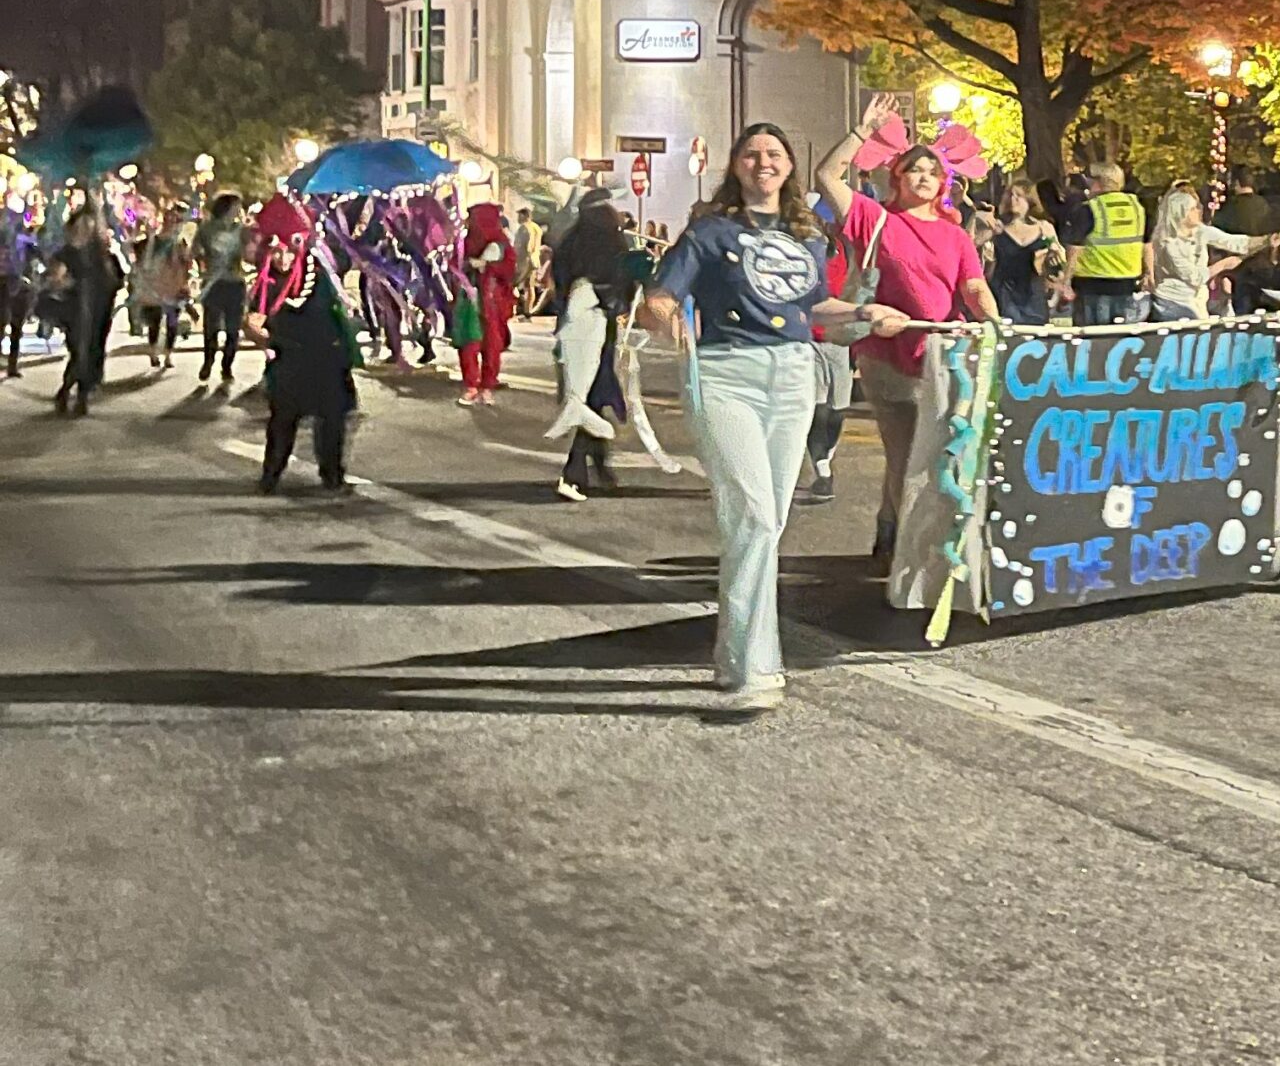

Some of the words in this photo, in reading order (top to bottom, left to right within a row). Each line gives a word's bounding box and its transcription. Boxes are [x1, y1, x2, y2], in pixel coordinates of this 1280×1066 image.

[1024, 400, 1246, 494] CREATURES
[1029, 536, 1115, 594] THE
[1130, 522, 1212, 584] DEEP
